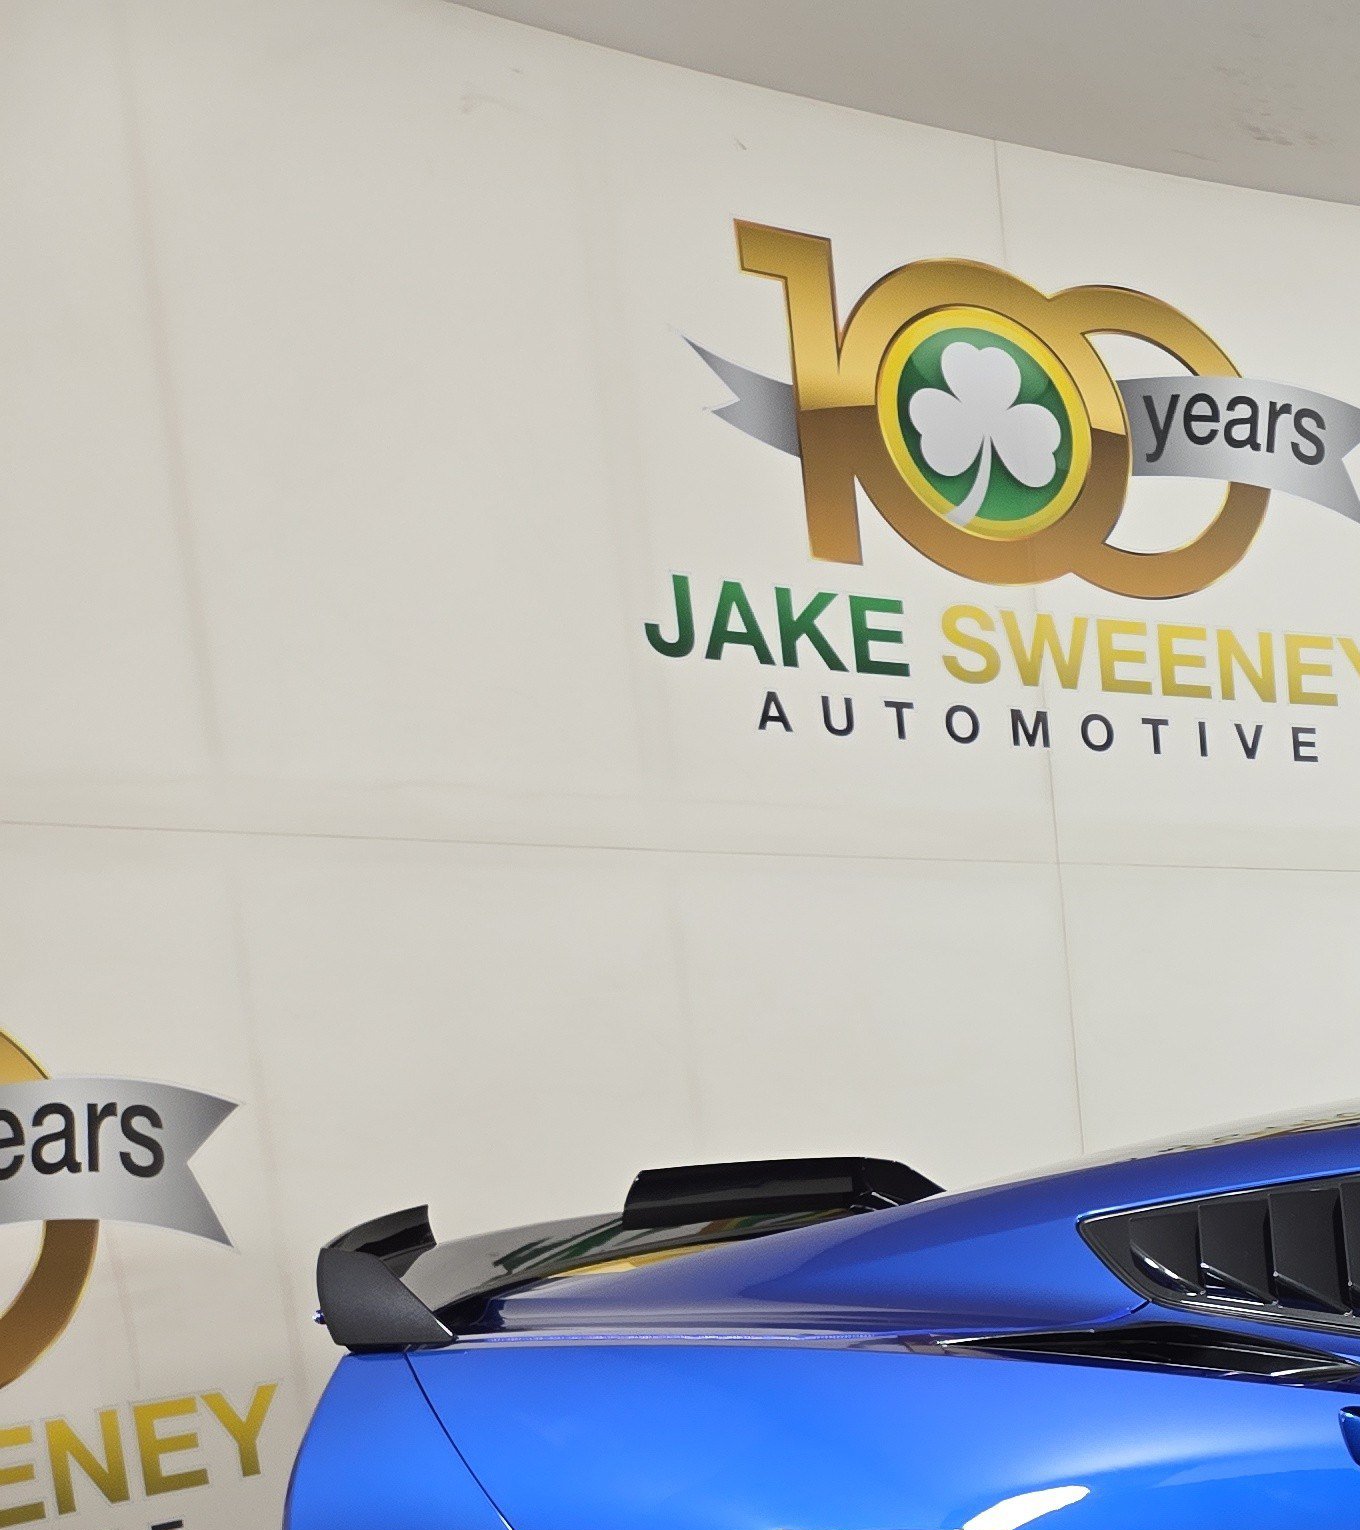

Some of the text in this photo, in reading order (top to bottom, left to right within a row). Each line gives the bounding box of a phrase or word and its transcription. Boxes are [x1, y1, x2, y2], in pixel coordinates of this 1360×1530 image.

[734, 218, 1328, 601] 100 years
[643, 573, 911, 678] JAKE
[757, 690, 1320, 764] AUTOMOTIVE
